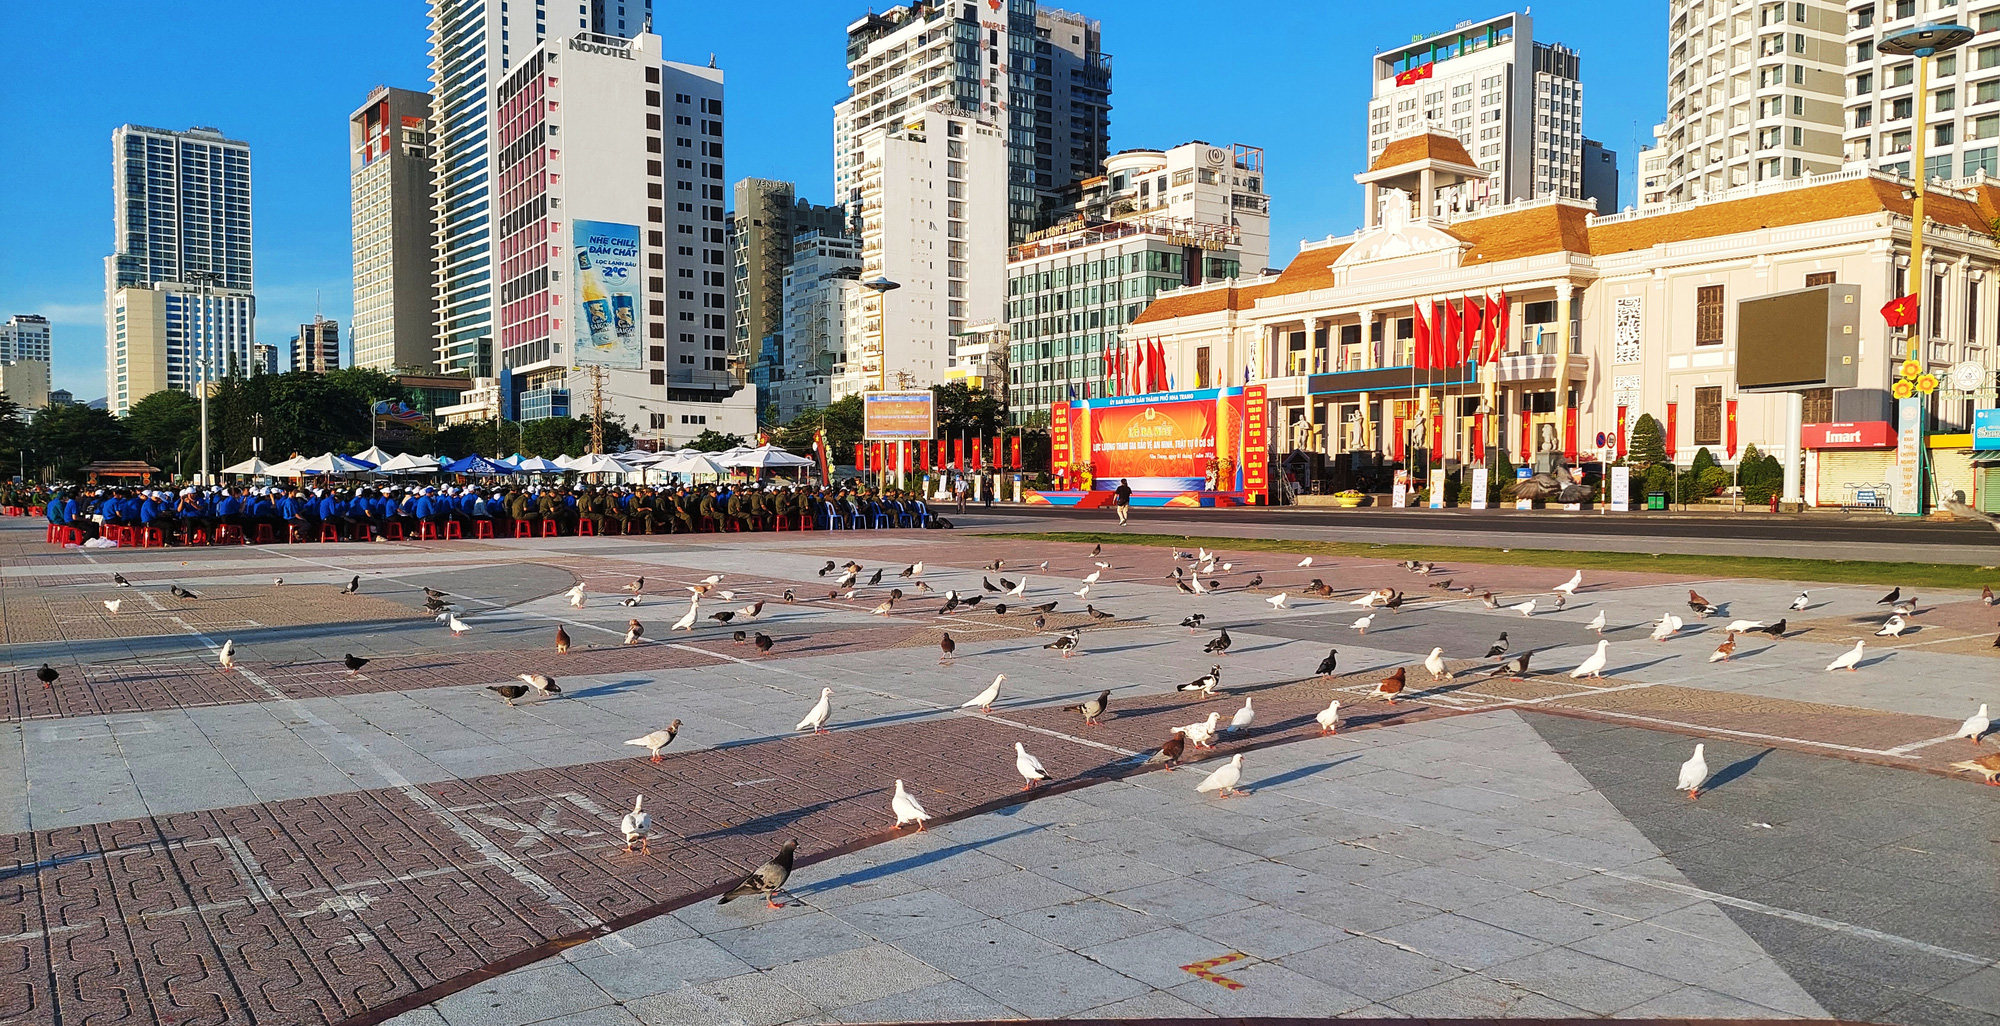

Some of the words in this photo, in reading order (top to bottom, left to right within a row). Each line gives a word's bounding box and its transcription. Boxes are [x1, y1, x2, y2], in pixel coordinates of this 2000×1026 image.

[982, 20, 1007, 33] MAPLE
[1412, 33, 1422, 42] ibis
[1455, 19, 1472, 30] HOTEL
[569, 38, 636, 60] NOVOTEL
[947, 106, 970, 118] BOSS
[1026, 230, 1045, 243] HAPPY
[1046, 225, 1063, 238] LIGHT
[1066, 220, 1086, 232] HOTEL
[589, 236, 609, 246] NHẸ
[611, 238, 636, 247] CHILL
[589, 245, 611, 256] ĐẬM
[1826, 430, 1861, 443] Imart
